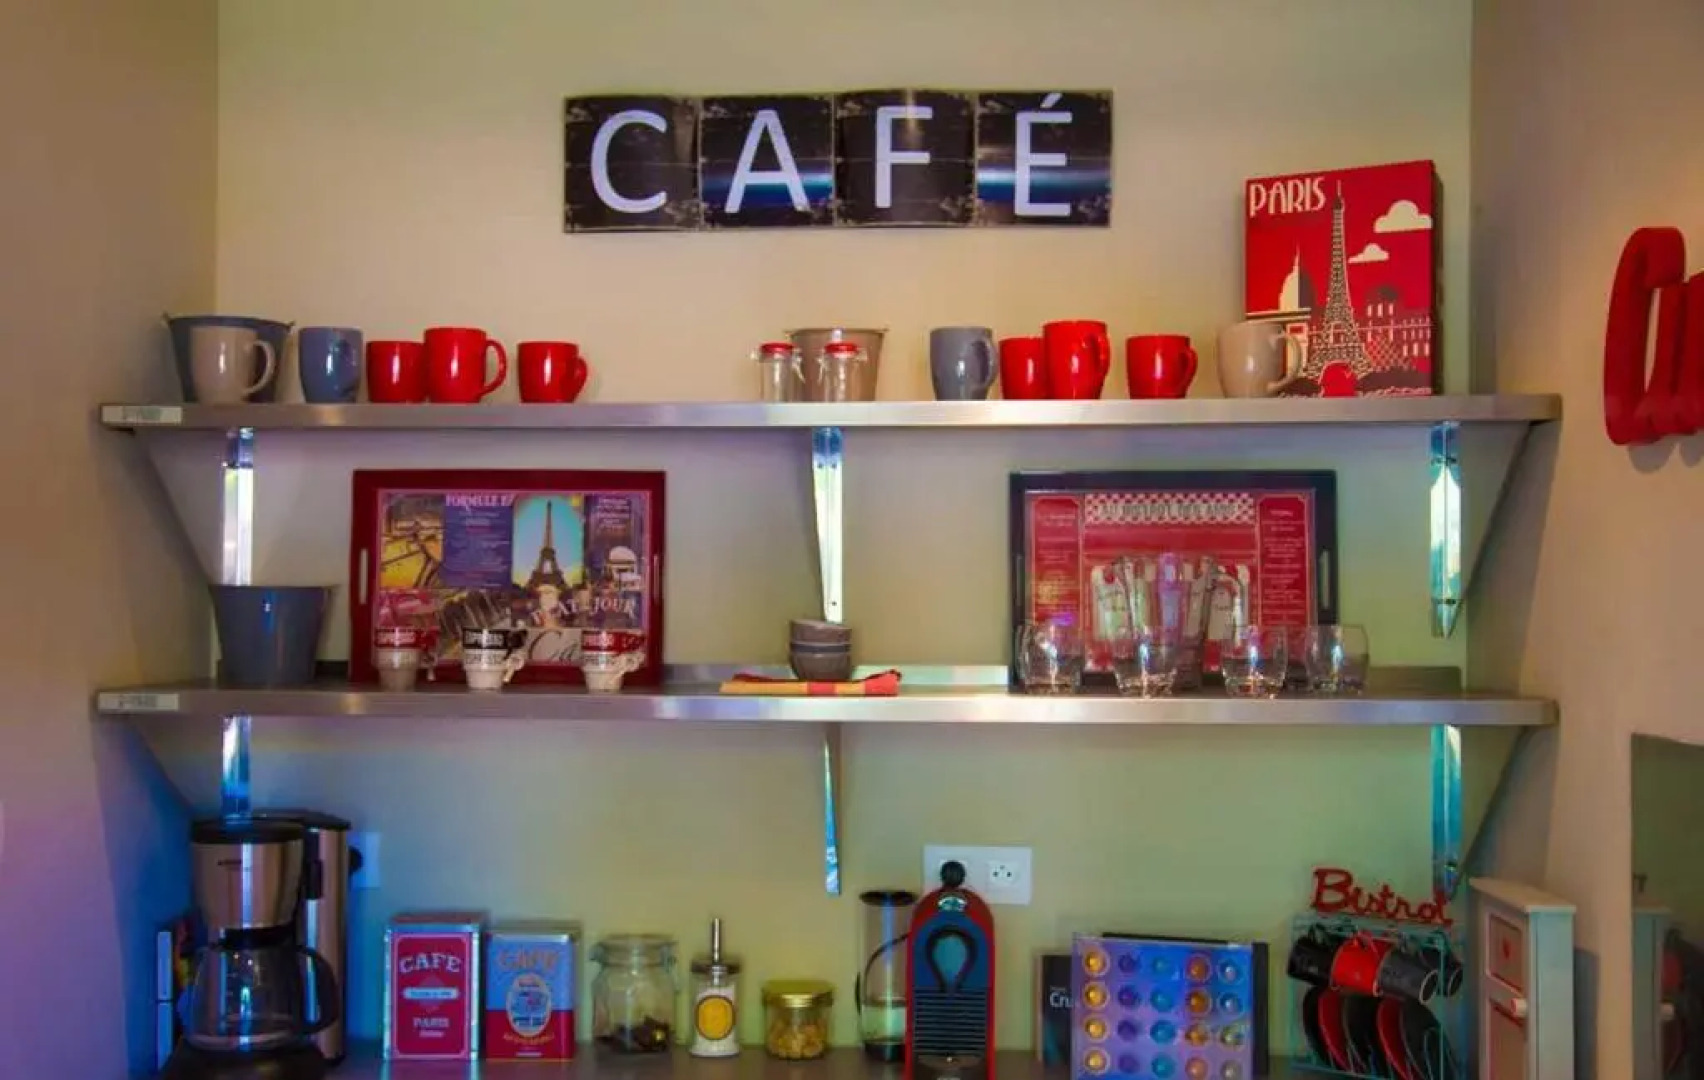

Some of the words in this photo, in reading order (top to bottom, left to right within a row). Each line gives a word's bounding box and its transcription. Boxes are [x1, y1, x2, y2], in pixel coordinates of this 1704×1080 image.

[589, 93, 1073, 214] CAFÉ
[1249, 176, 1326, 218] PARIS
[1310, 866, 1453, 925] Bistrot
